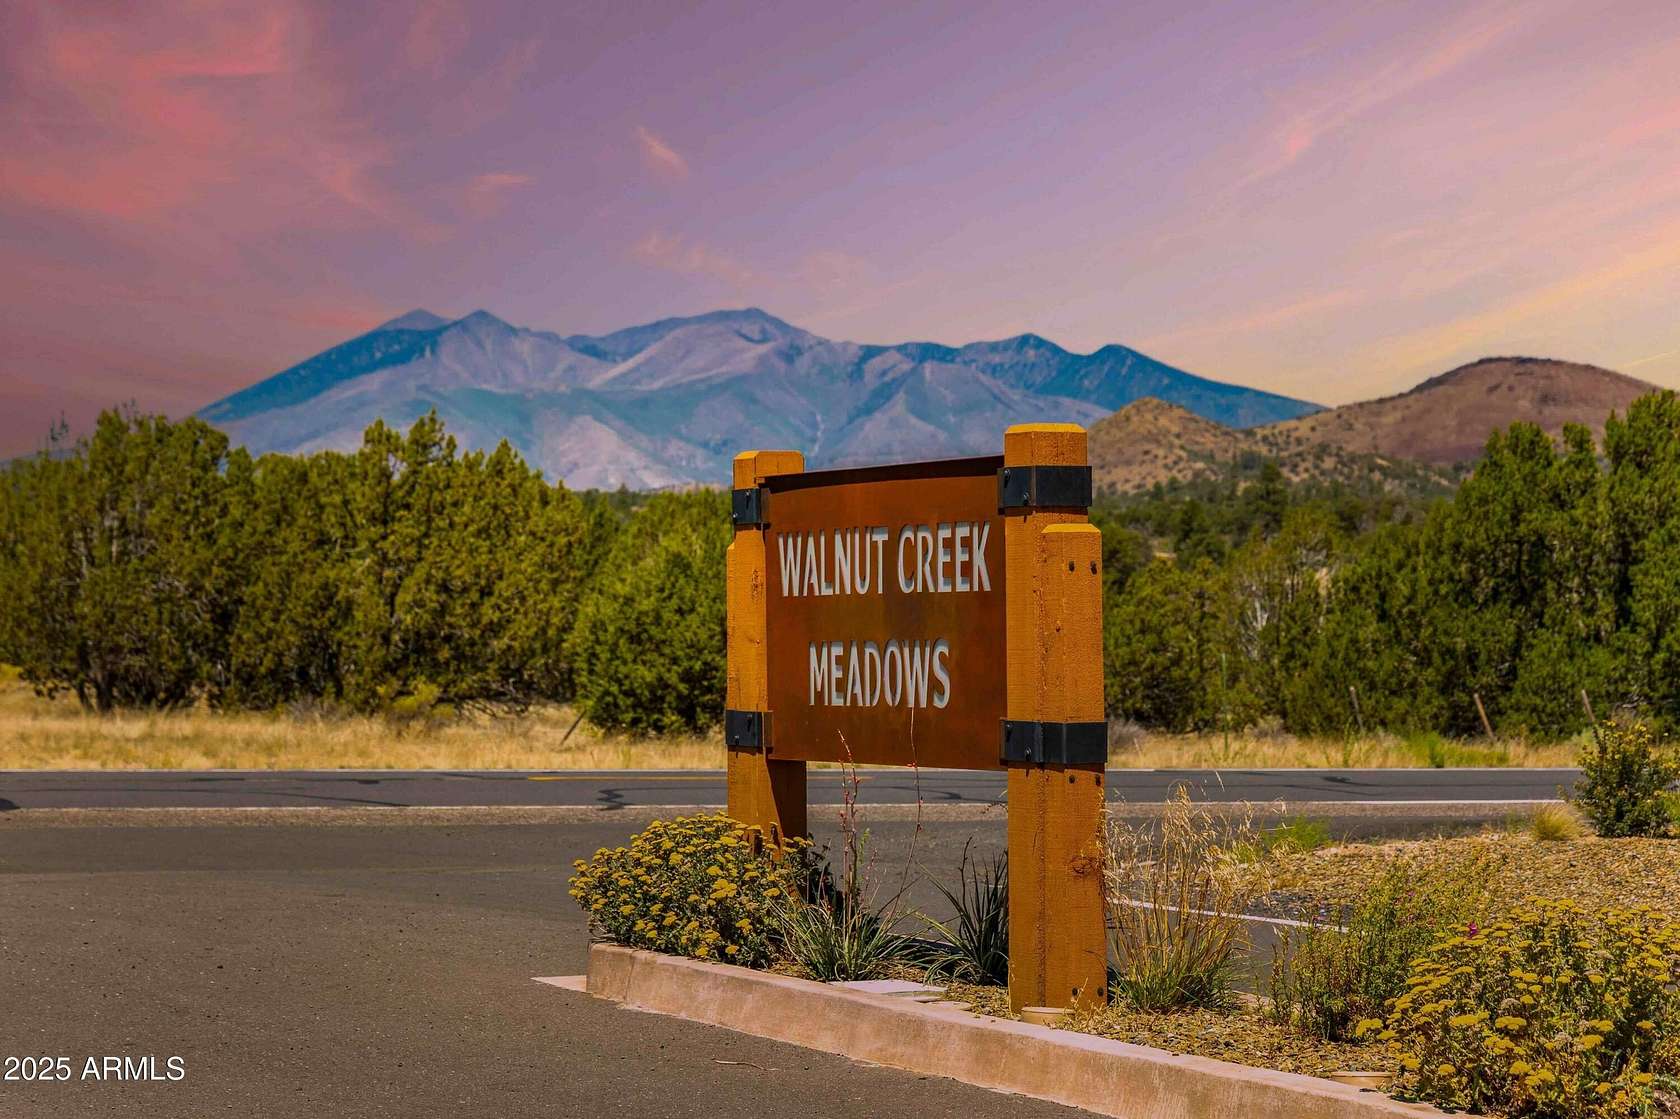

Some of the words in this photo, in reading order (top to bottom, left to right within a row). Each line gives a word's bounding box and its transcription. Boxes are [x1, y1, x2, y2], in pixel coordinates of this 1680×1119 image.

[778, 526, 889, 597] WALNUT
[897, 521, 991, 594] CREEK
[809, 639, 951, 709] MEADOWS
